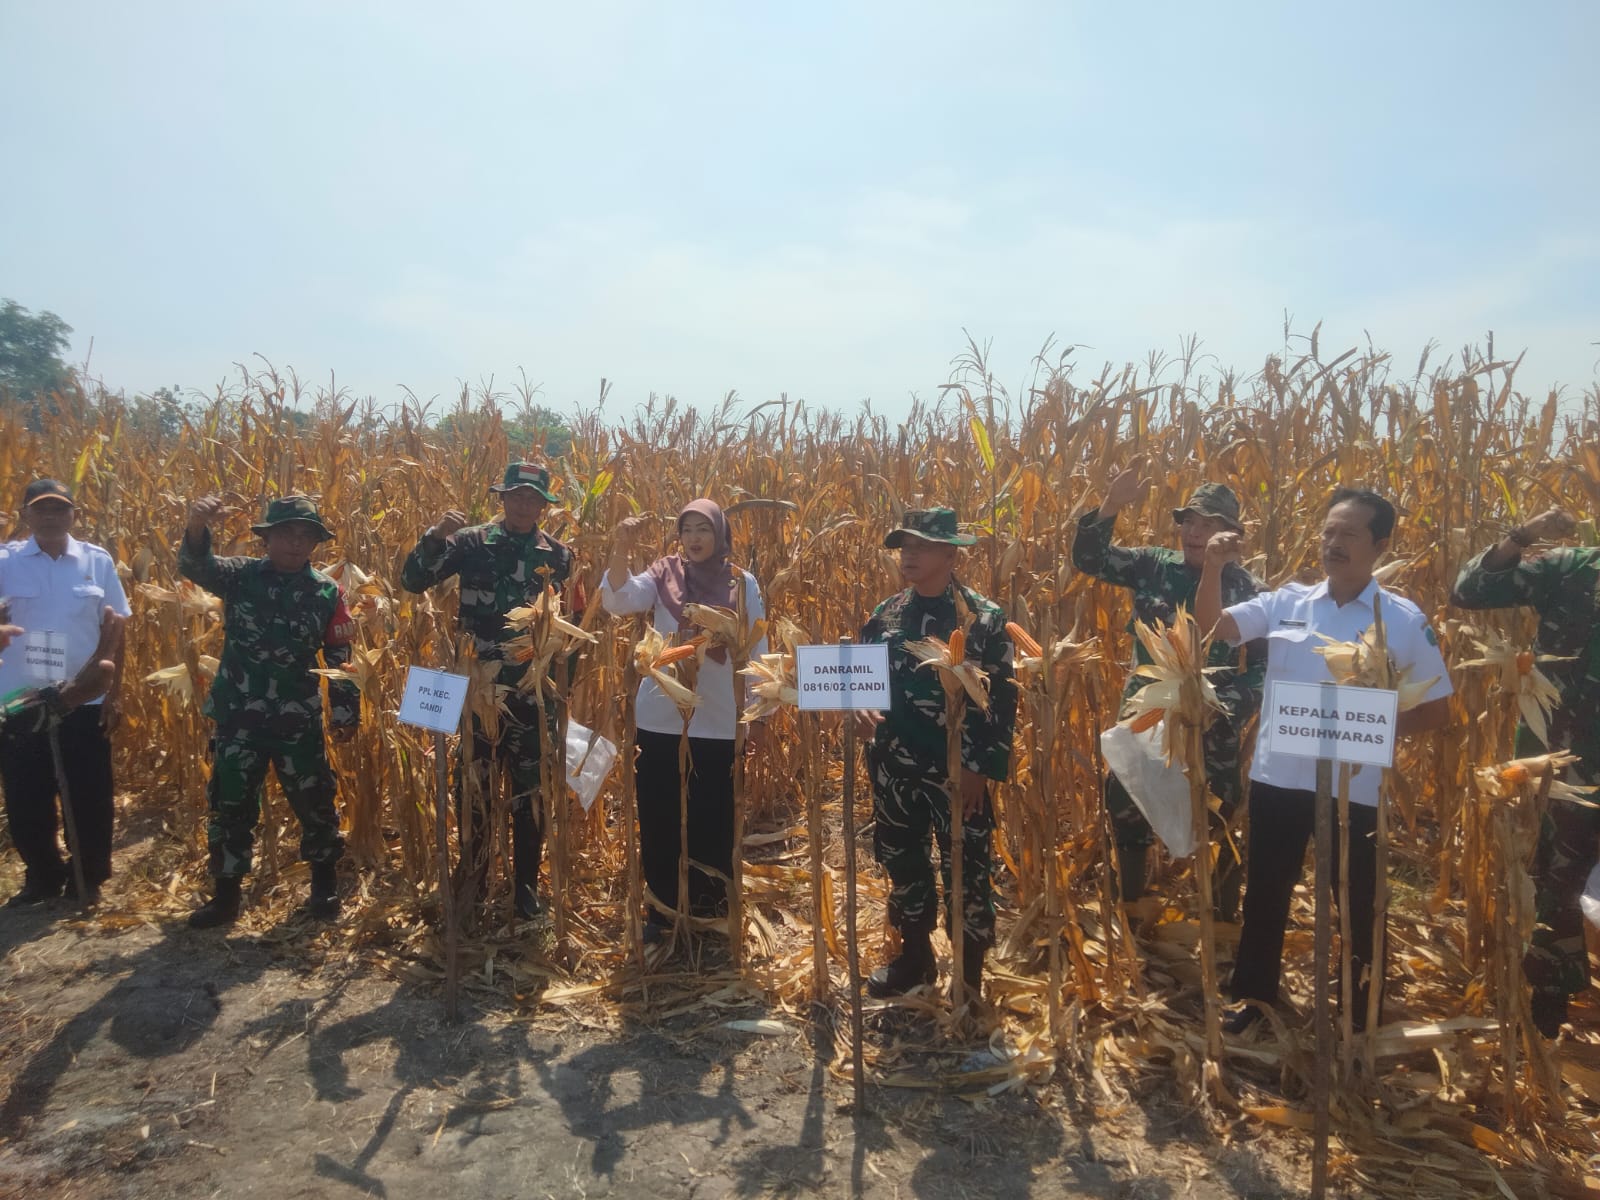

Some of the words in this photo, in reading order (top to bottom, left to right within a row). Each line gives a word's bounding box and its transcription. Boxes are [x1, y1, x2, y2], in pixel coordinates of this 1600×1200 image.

[814, 665, 873, 674] DANRAMIL
[418, 686, 431, 696] PPL
[433, 689, 451, 700] KEC.
[803, 682, 846, 692] 0816/02
[849, 682, 885, 691] CANDI
[419, 701, 443, 714] CANDI
[1279, 704, 1340, 720] KEPALA
[1345, 711, 1387, 725] DESA
[1278, 724, 1385, 745] SUGIHWARAS
